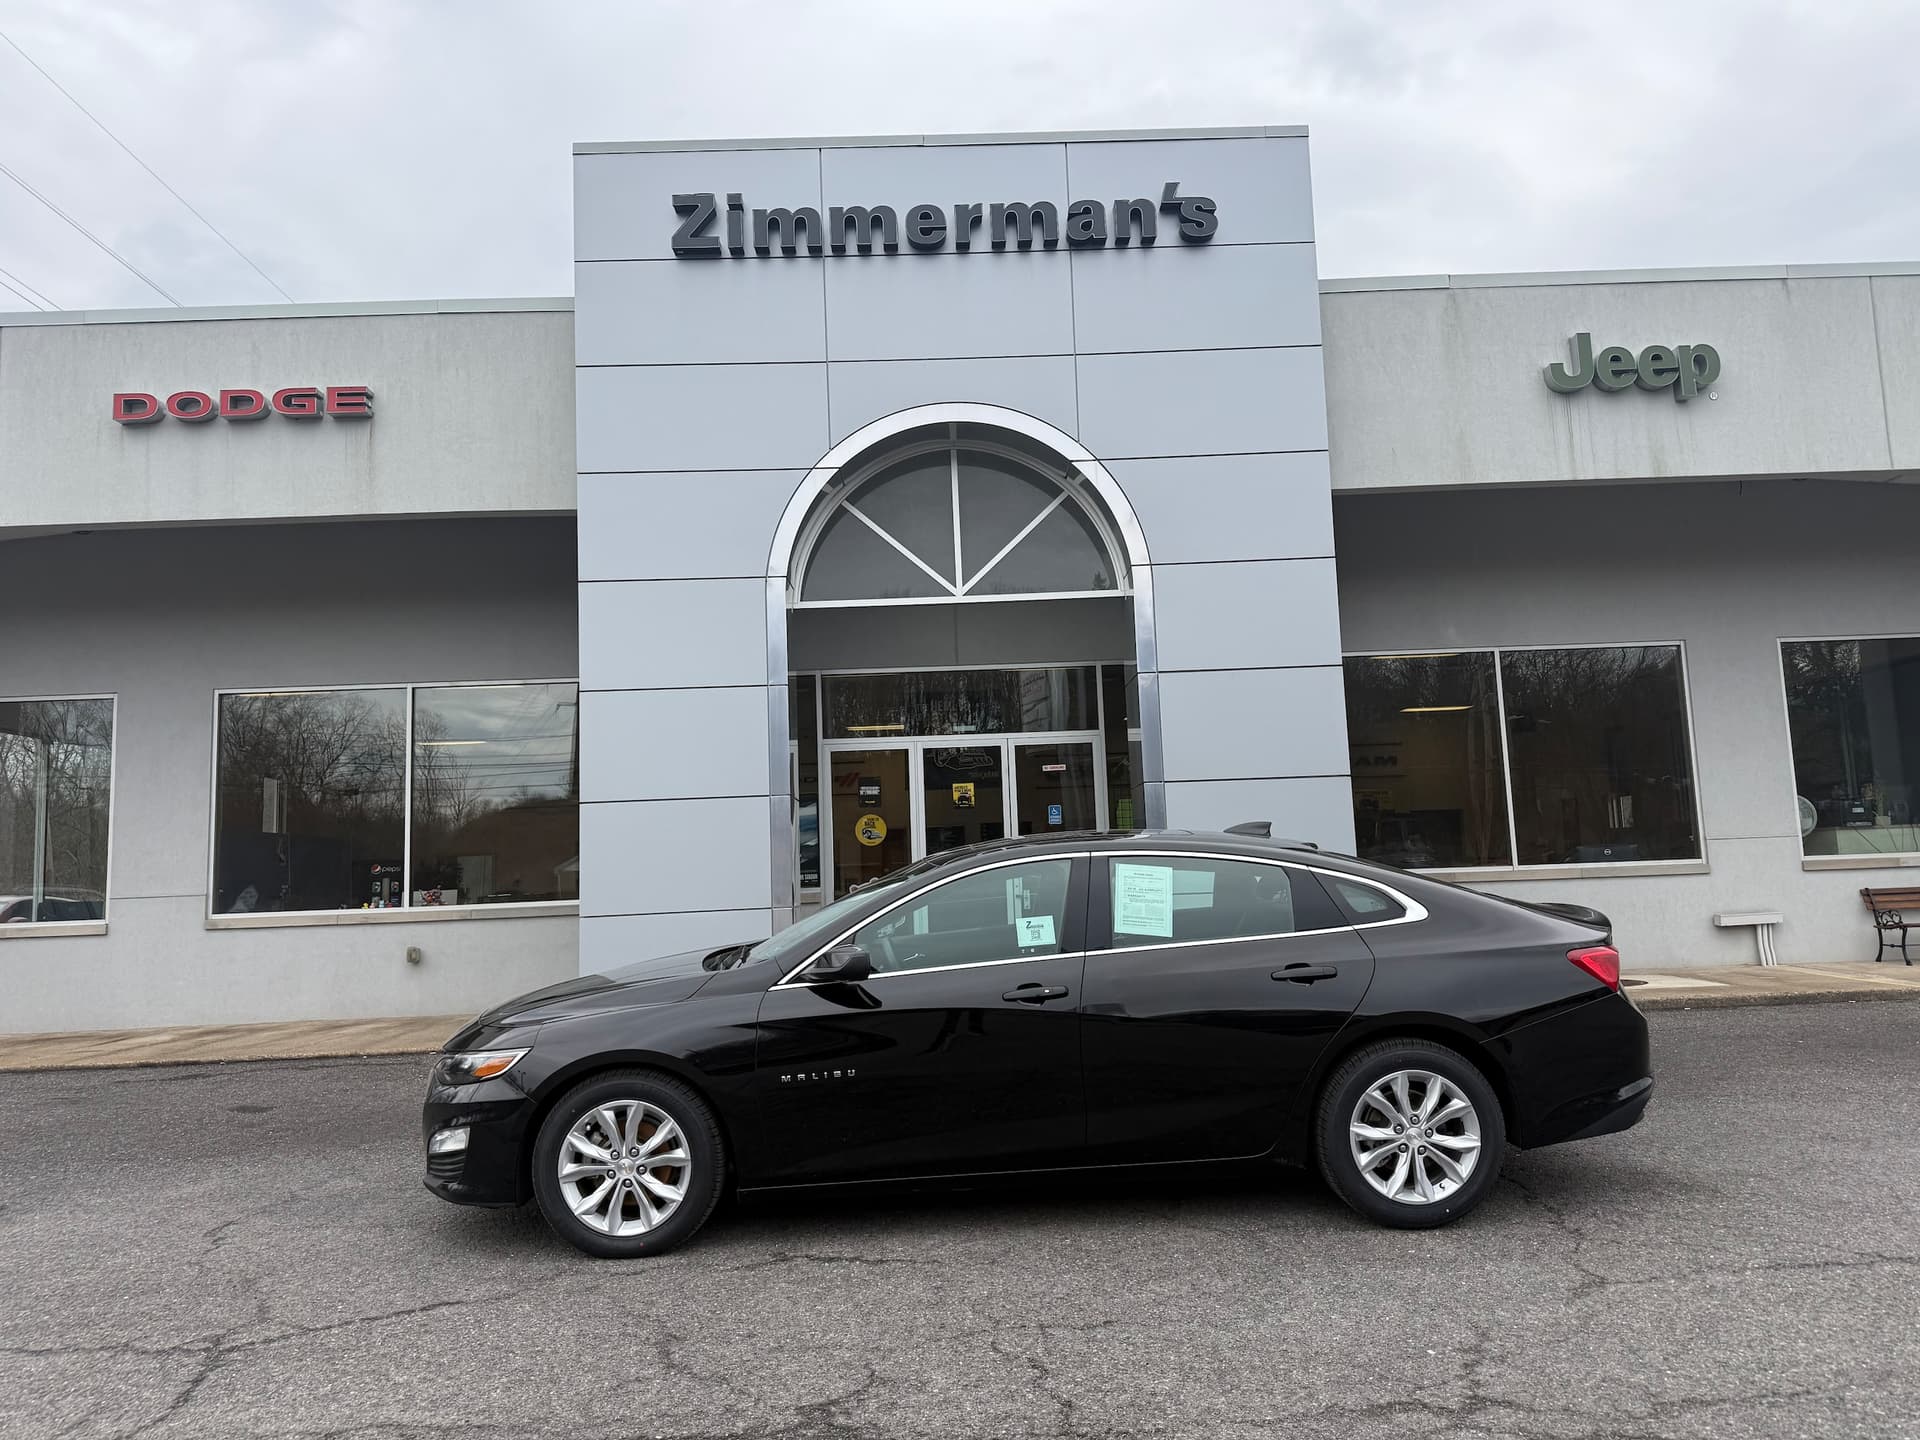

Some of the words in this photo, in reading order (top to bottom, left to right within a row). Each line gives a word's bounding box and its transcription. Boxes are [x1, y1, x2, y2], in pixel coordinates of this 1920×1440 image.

[671, 182, 1217, 256] Zimmerman's
[1543, 332, 1721, 402] Jeep
[113, 386, 374, 425] DODGE
[381, 865, 401, 873] pepsi
[781, 1069, 856, 1083] MALIBU
